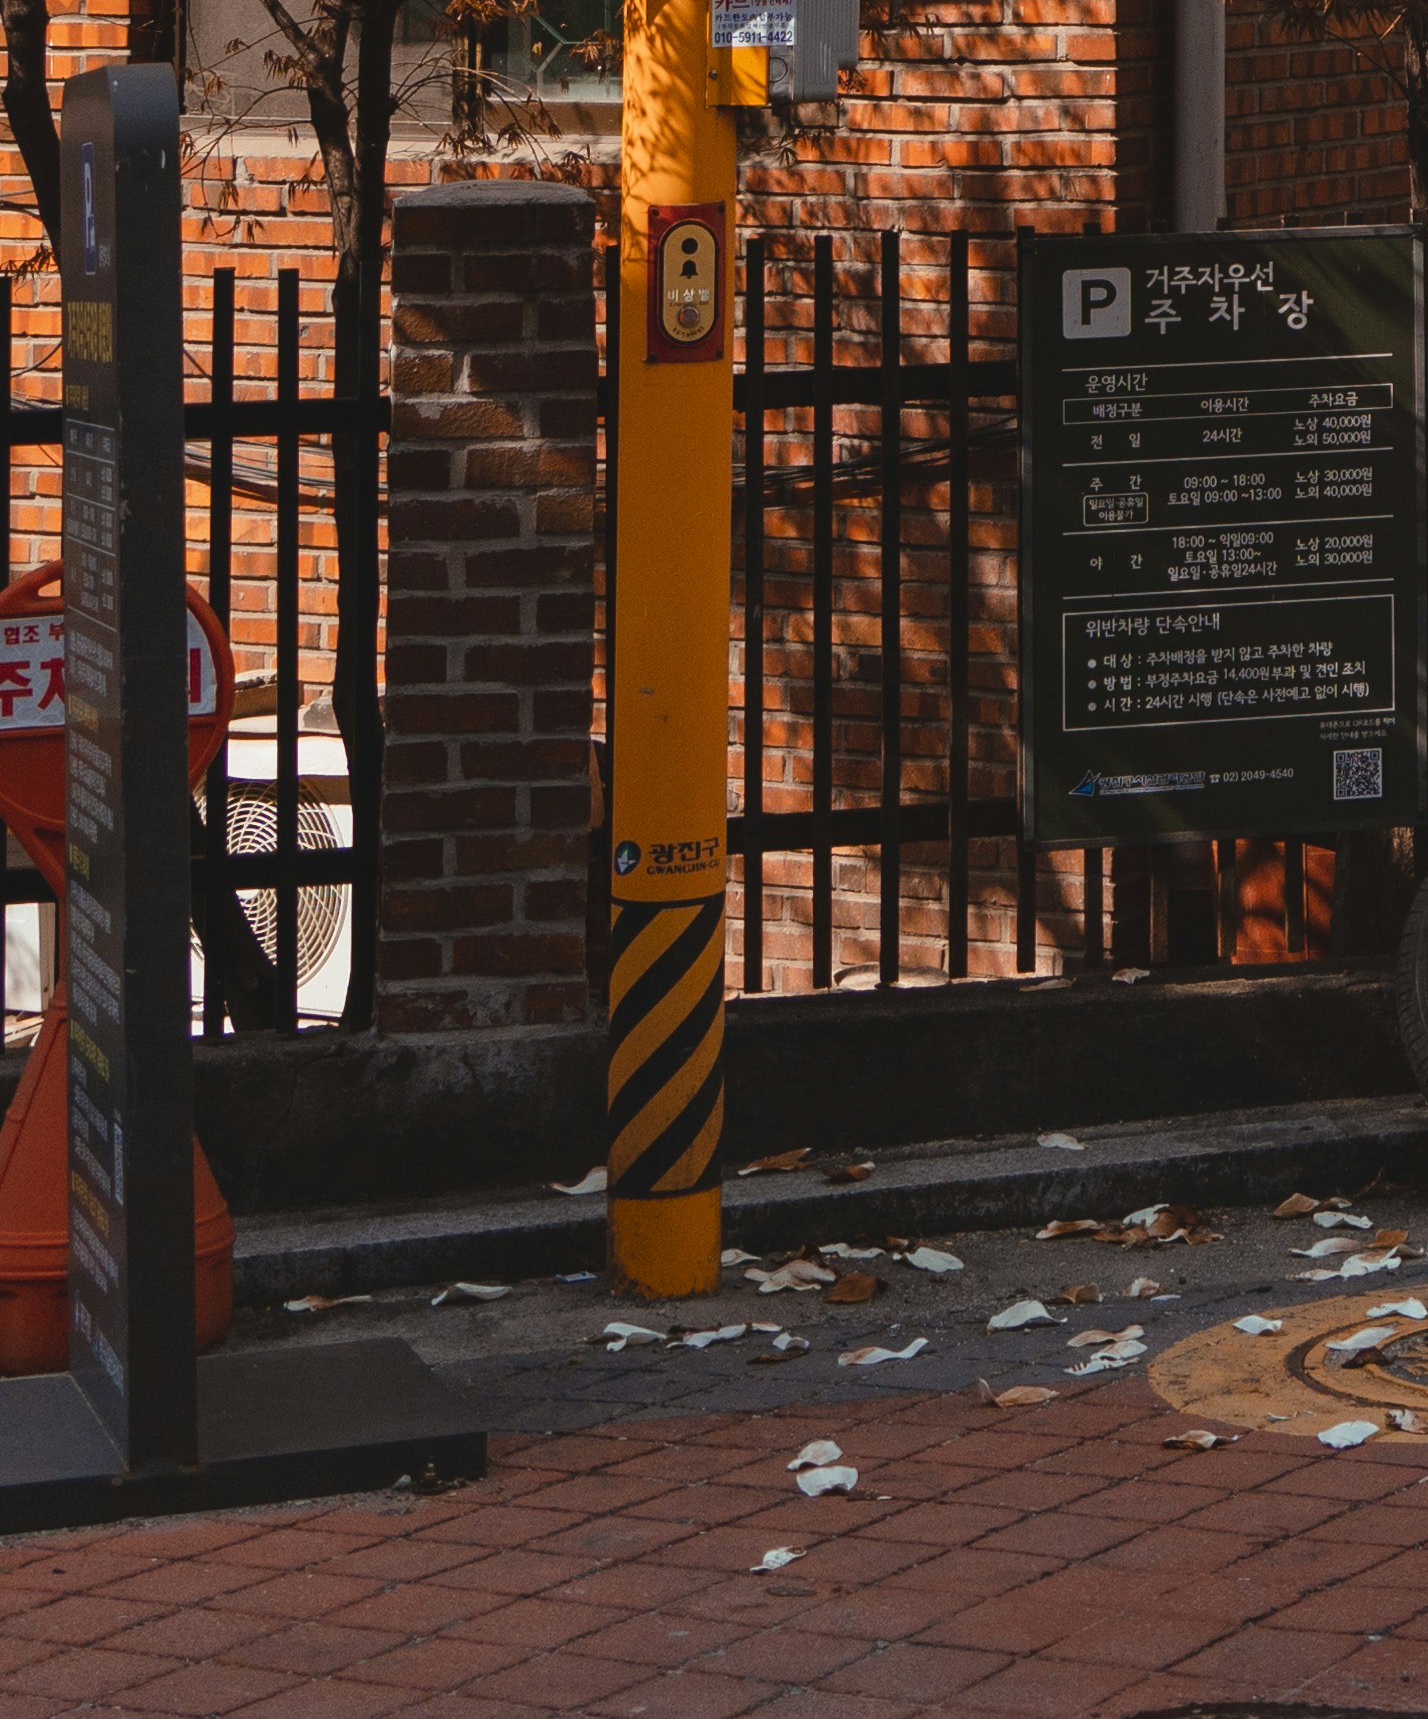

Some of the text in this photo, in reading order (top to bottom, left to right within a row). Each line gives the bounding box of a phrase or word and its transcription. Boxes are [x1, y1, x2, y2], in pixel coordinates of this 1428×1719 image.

[714, 30, 793, 43] 010-5911-4422
[1145, 261, 1275, 294] 거주자우선
[1081, 278, 1117, 326] P
[1085, 373, 1149, 394] 운영시간
[1092, 392, 1359, 419] 배정구분 이용시간 주차요금
[1293, 414, 1372, 431] 노상 40,000원
[1202, 429, 1242, 444] 24시간
[1293, 430, 1372, 447] 노외 50,000원
[1184, 475, 1217, 489] 09:00
[1232, 473, 1266, 487] 18:00
[1295, 469, 1319, 483] 노상
[1323, 466, 1373, 482] 30,000원
[1167, 490, 1201, 506] 토요일
[1204, 489, 1238, 503] 09:00
[1295, 485, 1319, 499] 노외
[1323, 482, 1373, 498] 40,000원
[1098, 509, 1134, 521] 이용불가
[1172, 535, 1205, 549] 18:00
[1219, 532, 1274, 547] 익일09:00
[1295, 537, 1320, 551] 노상
[1325, 533, 1374, 549] 20,000원
[1184, 549, 1218, 565] 토요일
[1295, 552, 1320, 567] 노외
[1325, 549, 1374, 565] 30,000원
[4, 625, 40, 645] 협조
[1086, 612, 1221, 639] 위반차량 단속안내
[1146, 649, 1207, 666] 주차배정을
[1211, 646, 1236, 663] 받지
[1239, 644, 1264, 661] 않고
[1268, 641, 1305, 659] 주차한
[1308, 640, 1333, 657] 차량
[1145, 670, 1219, 689] 부정주차요금
[1300, 664, 1311, 680] 및
[1315, 661, 1339, 679] 견인
[1341, 659, 1366, 677] 조치
[1145, 693, 1184, 710] 24시간
[1188, 691, 1213, 709] 시행
[1217, 689, 1259, 706] (단속은
[1262, 686, 1312, 703] 사전예고
[1315, 683, 1338, 701] 없이
[1341, 681, 1370, 699] 시행)
[1241, 768, 1294, 781] 2049-4540
[648, 837, 720, 864] 광진구
[646, 858, 721, 875] GWANGJIN-GU
